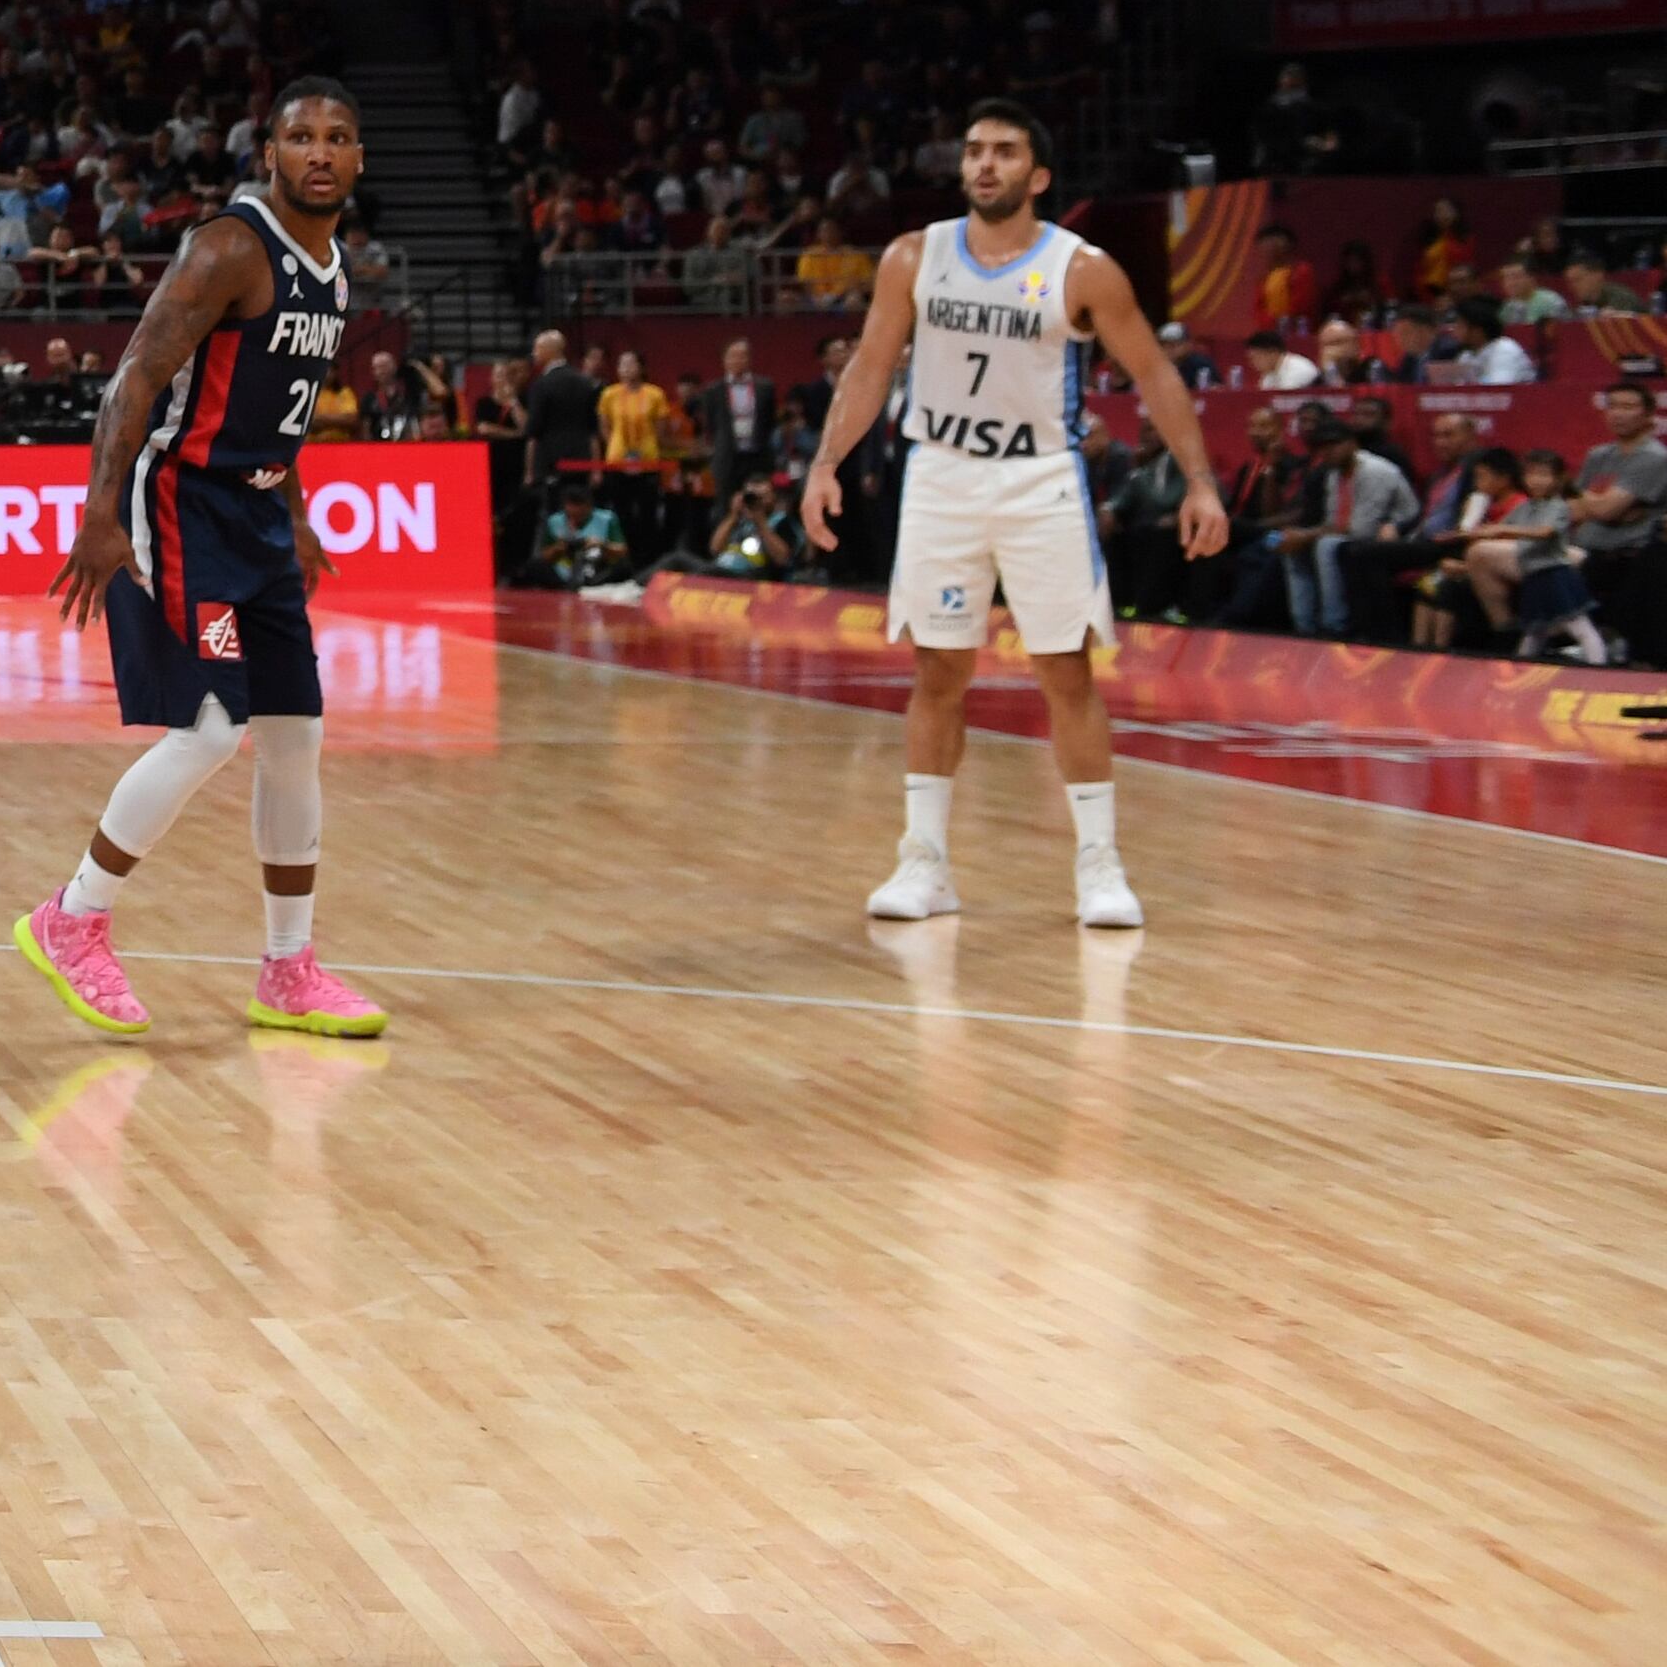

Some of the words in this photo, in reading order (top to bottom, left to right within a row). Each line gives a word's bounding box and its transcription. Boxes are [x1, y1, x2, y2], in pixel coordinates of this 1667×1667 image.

[927, 297, 1042, 341] ARGENTINA
[966, 352, 990, 397] 7
[922, 407, 1037, 459] VISA
